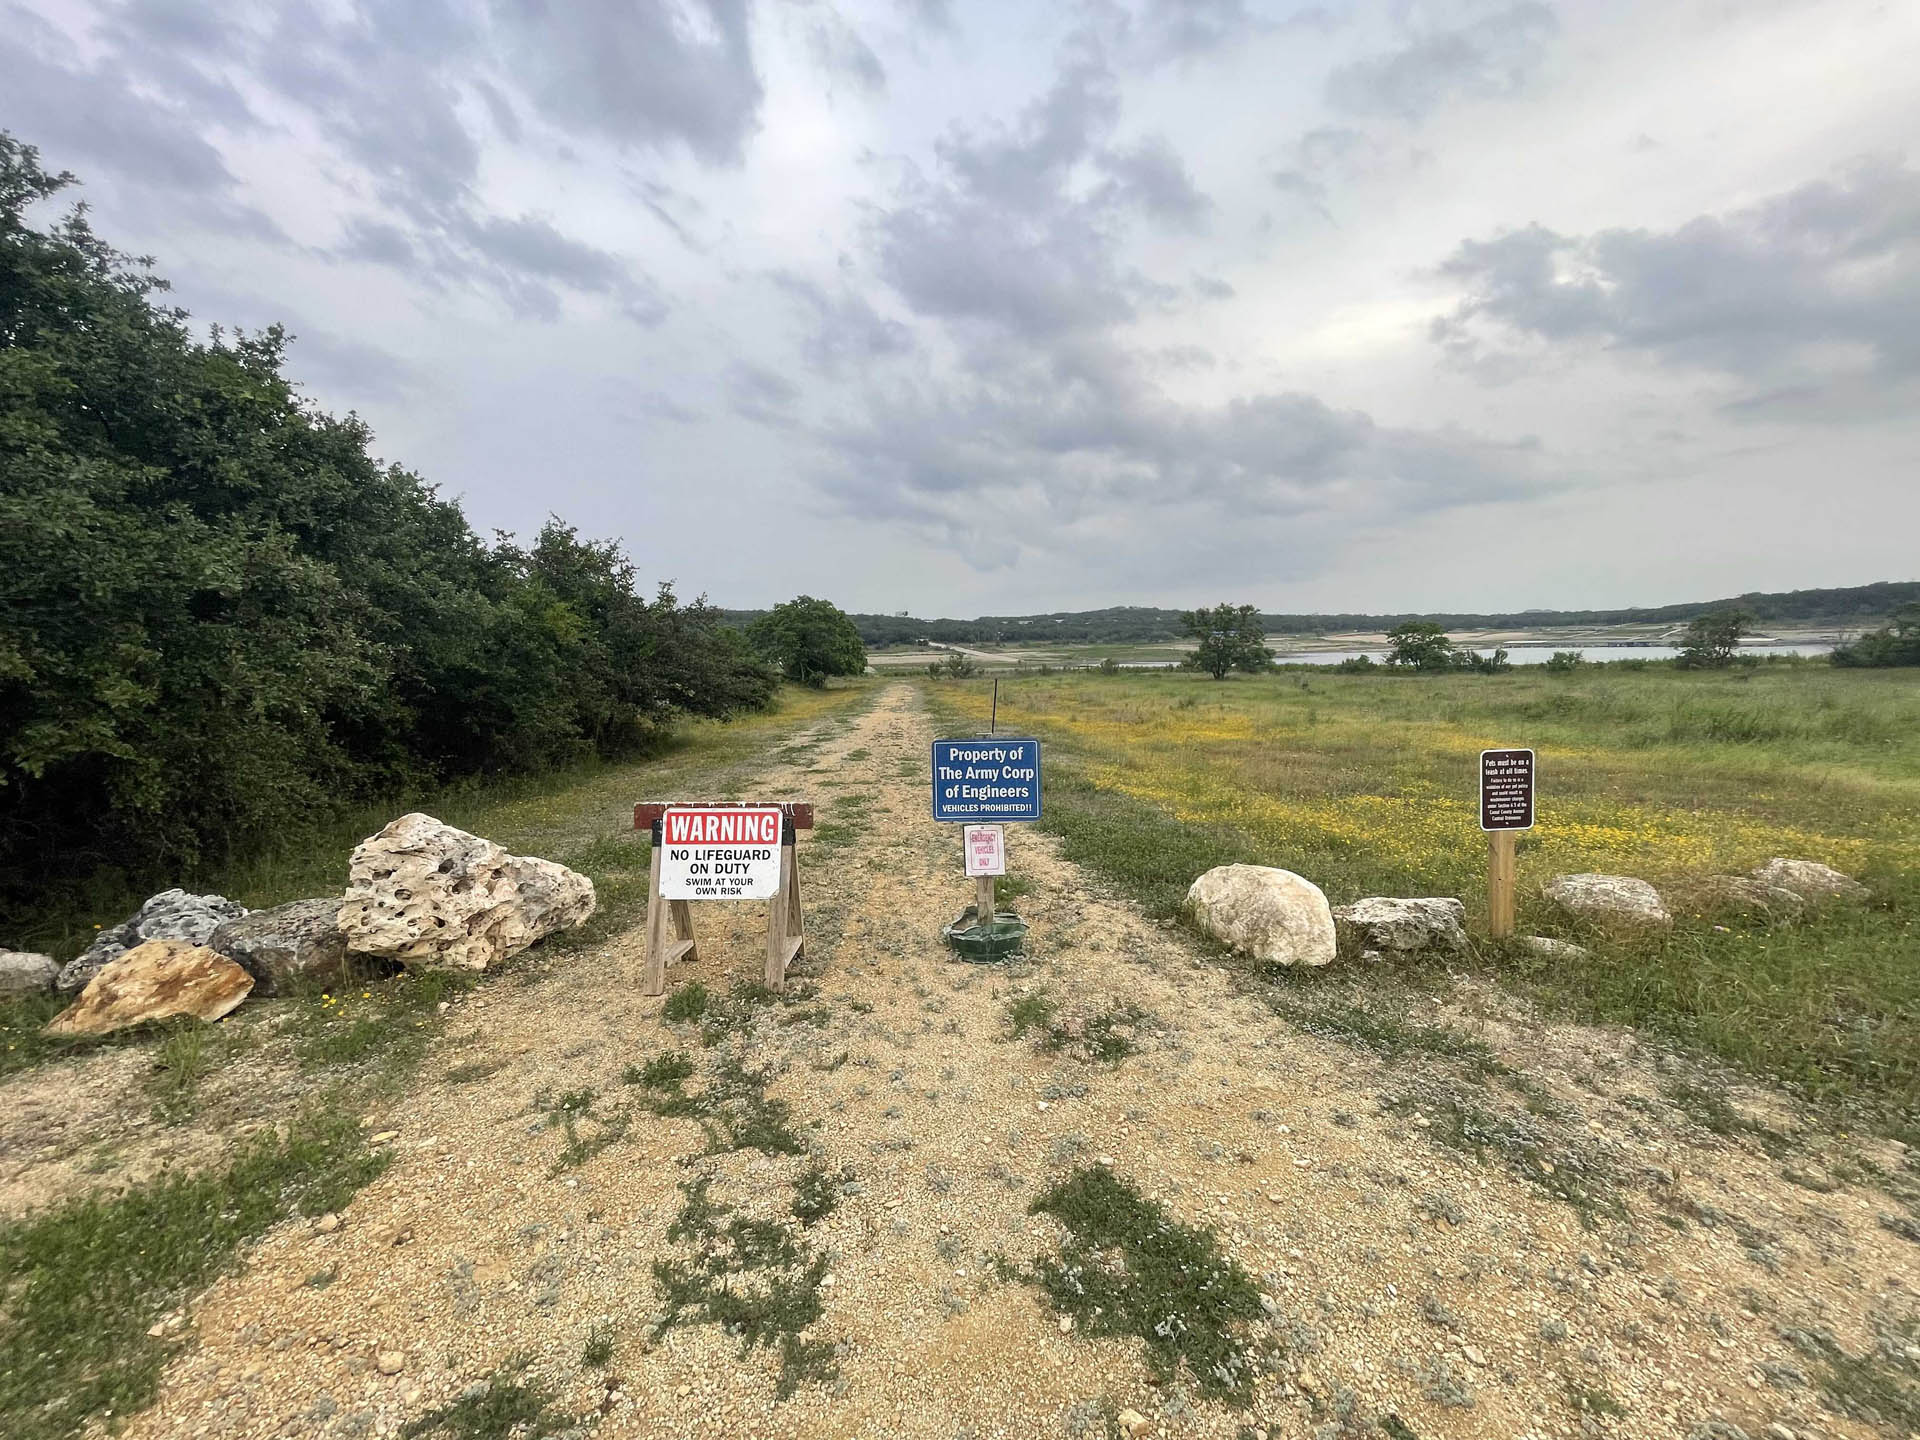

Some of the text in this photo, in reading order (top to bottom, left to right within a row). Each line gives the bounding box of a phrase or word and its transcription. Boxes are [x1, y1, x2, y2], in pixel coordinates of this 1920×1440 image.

[950, 746, 1024, 764] Property of
[1485, 759, 1496, 767] Pets
[938, 766, 1035, 782] The Army Corp
[945, 784, 1029, 801] of Engineers
[942, 803, 1032, 812] VEHICLES PROHIBITED!!
[671, 814, 774, 842] WARNING
[670, 849, 771, 861] NO LIFEGUARD
[690, 863, 750, 875] ON DUTY
[685, 878, 754, 886] SWIM AT YOUR
[695, 887, 742, 895] OWN RISK
